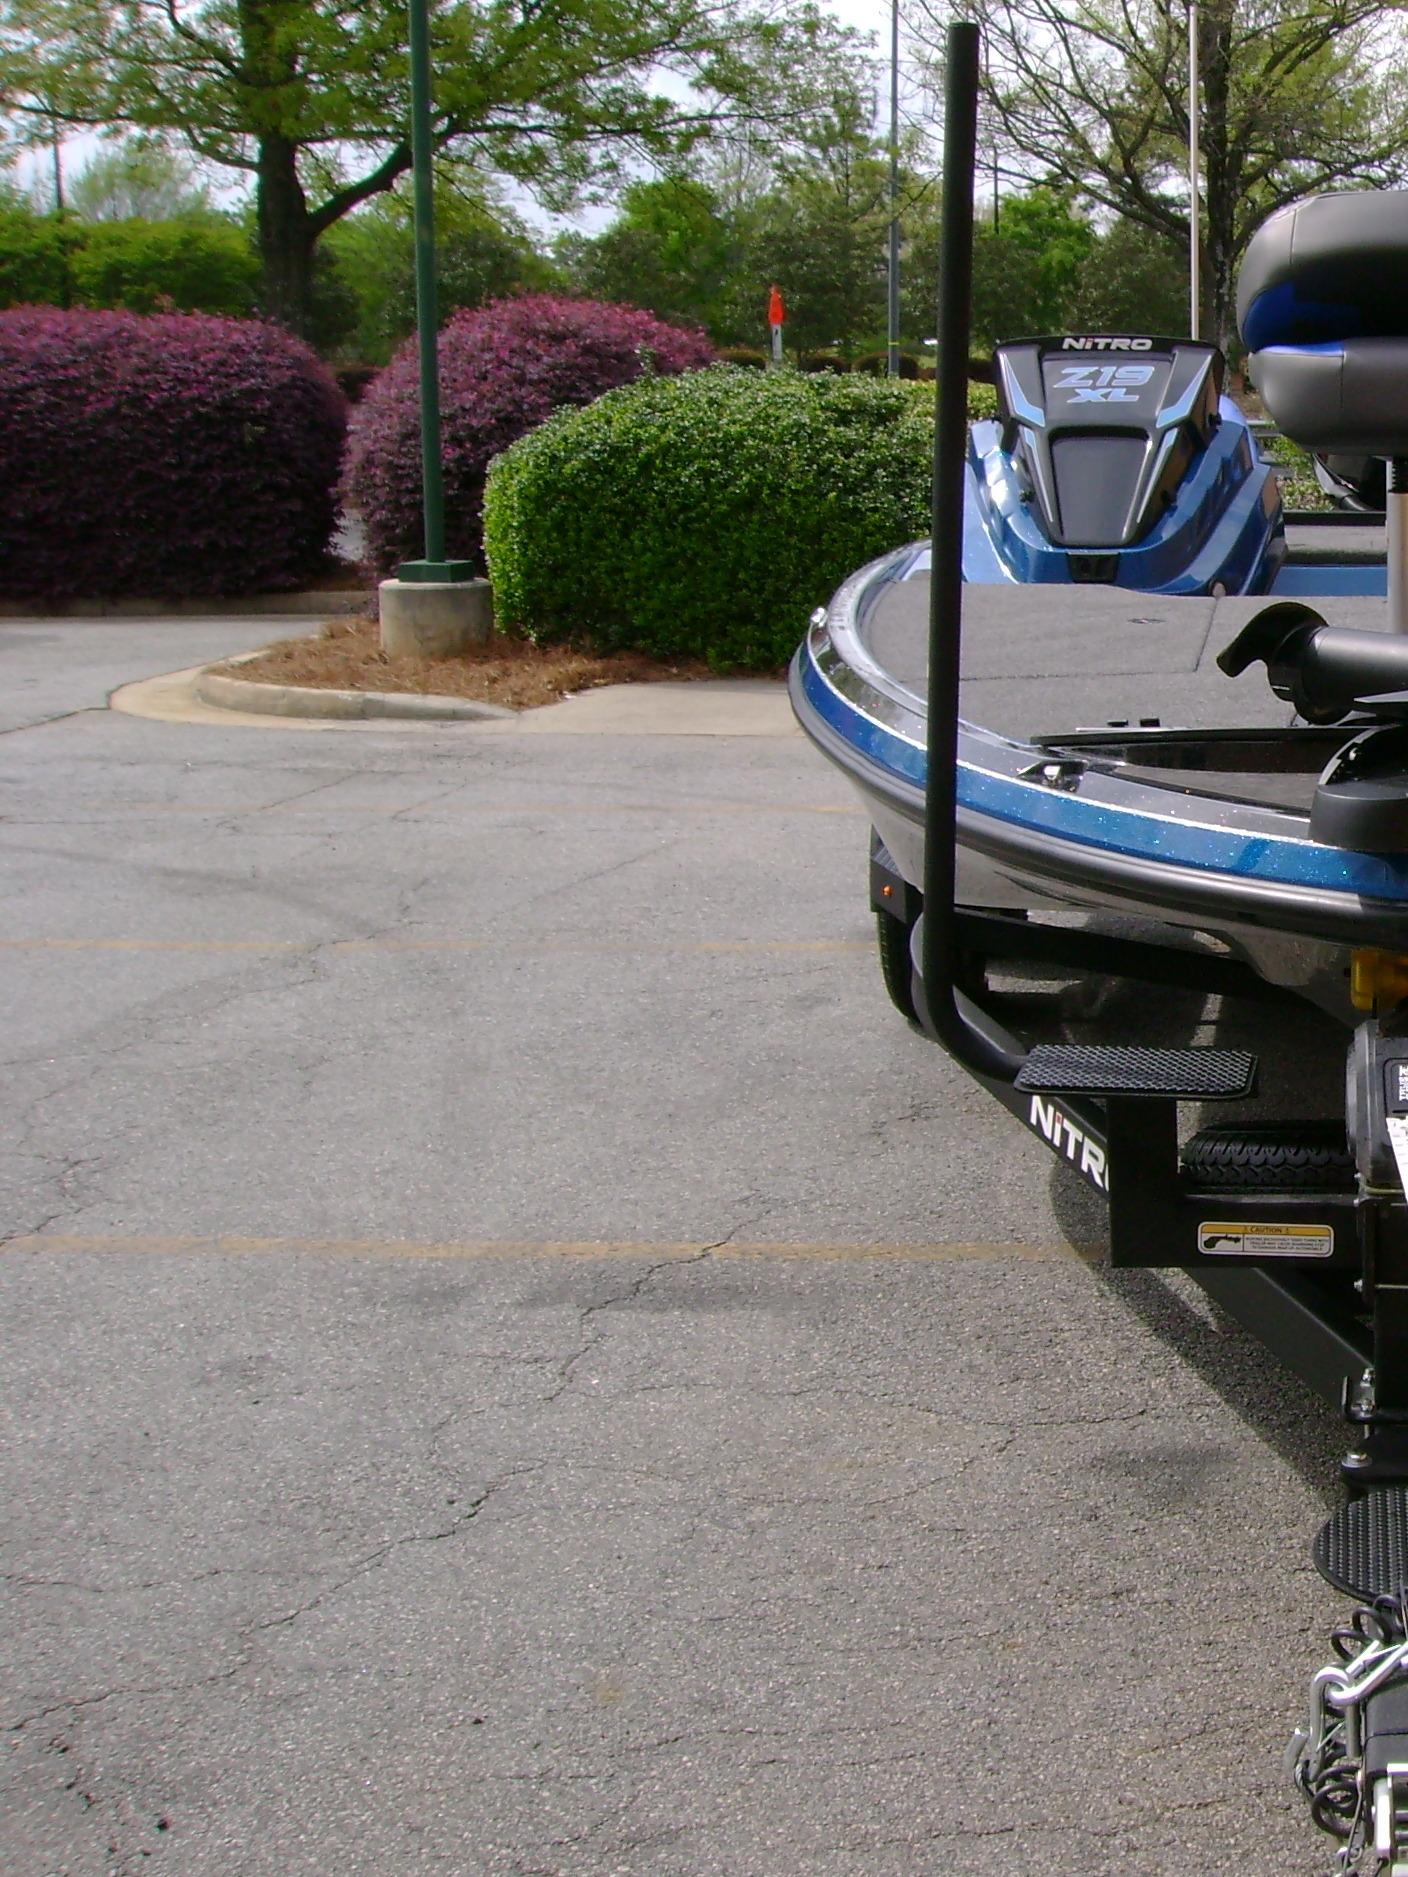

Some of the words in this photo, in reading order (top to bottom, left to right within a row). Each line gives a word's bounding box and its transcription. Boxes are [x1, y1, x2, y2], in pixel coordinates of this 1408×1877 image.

[1053, 365, 1156, 388] Z19
[1066, 388, 1141, 403] XL
[1030, 1094, 1110, 1193] NiTR
[1250, 1225, 1283, 1234] CAUTION
